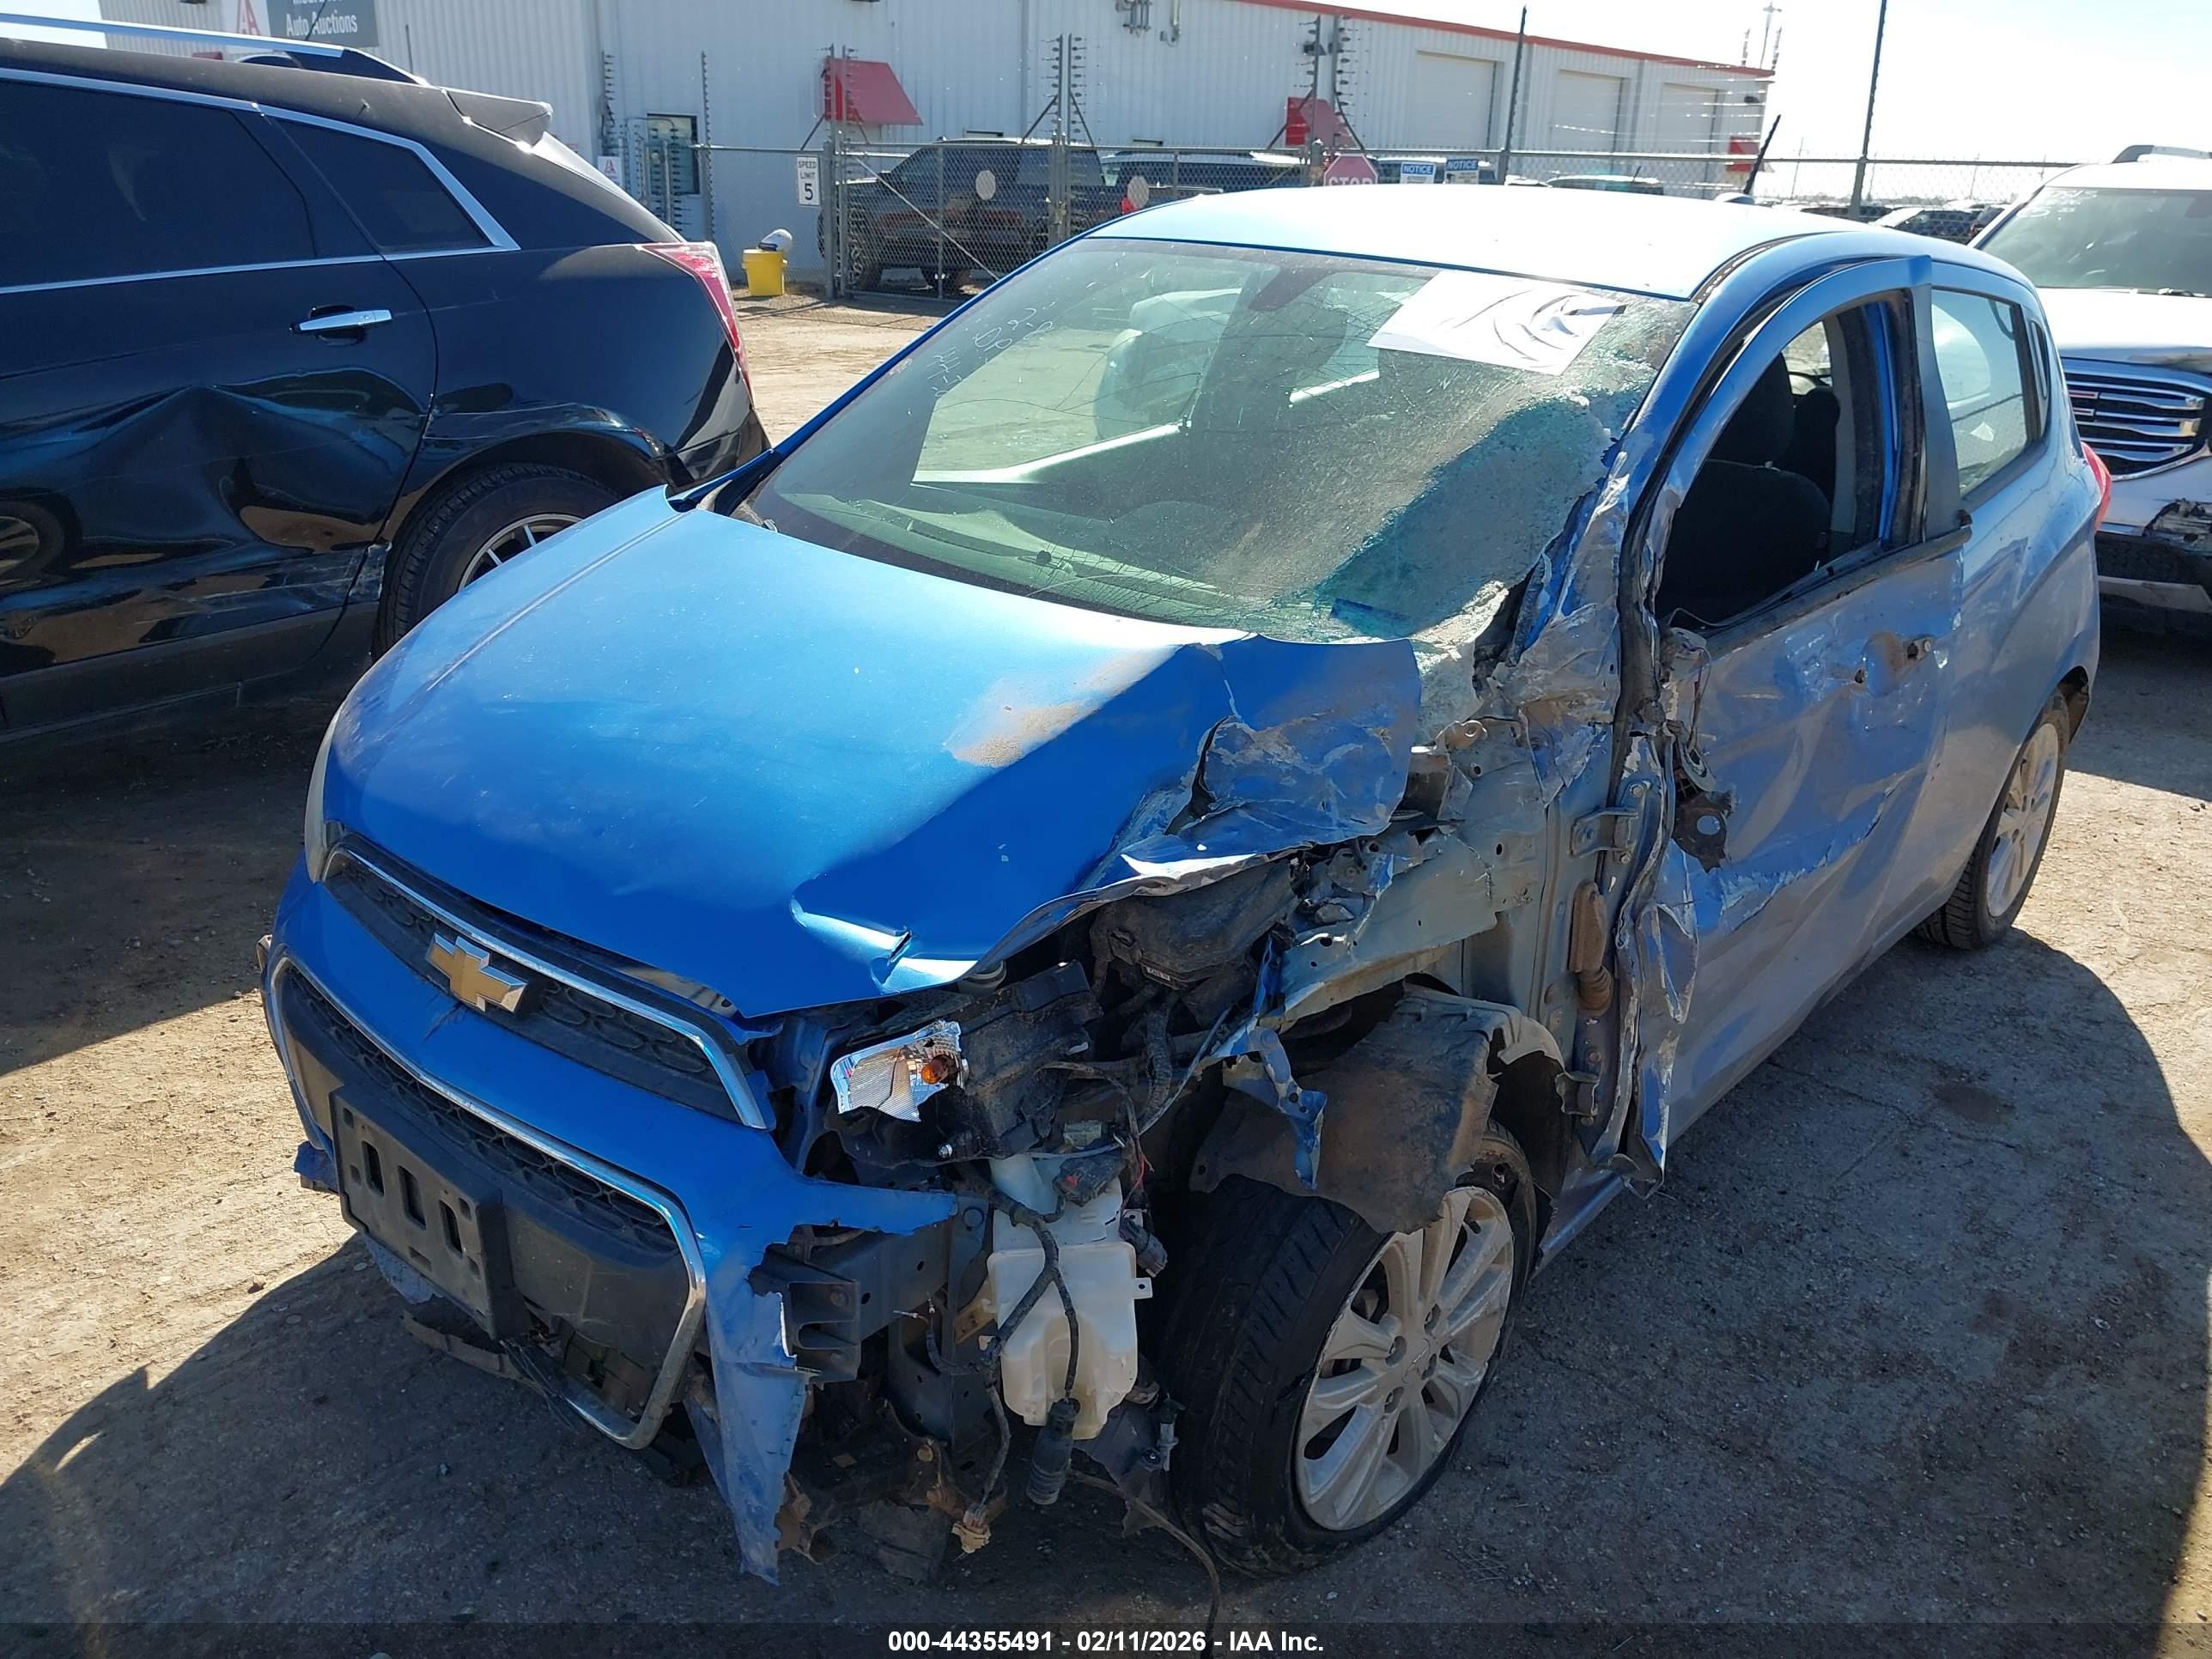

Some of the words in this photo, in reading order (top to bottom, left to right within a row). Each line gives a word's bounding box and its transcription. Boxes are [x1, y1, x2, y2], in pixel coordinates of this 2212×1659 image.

[286, 13, 310, 36] Auto
[312, 9, 358, 35] Auctions
[798, 161, 817, 169] SPEED
[1403, 164, 1432, 174] NOTICE
[1448, 160, 1477, 170] NOTICE
[799, 171, 816, 179] LIMIT
[804, 182, 814, 201] 5
